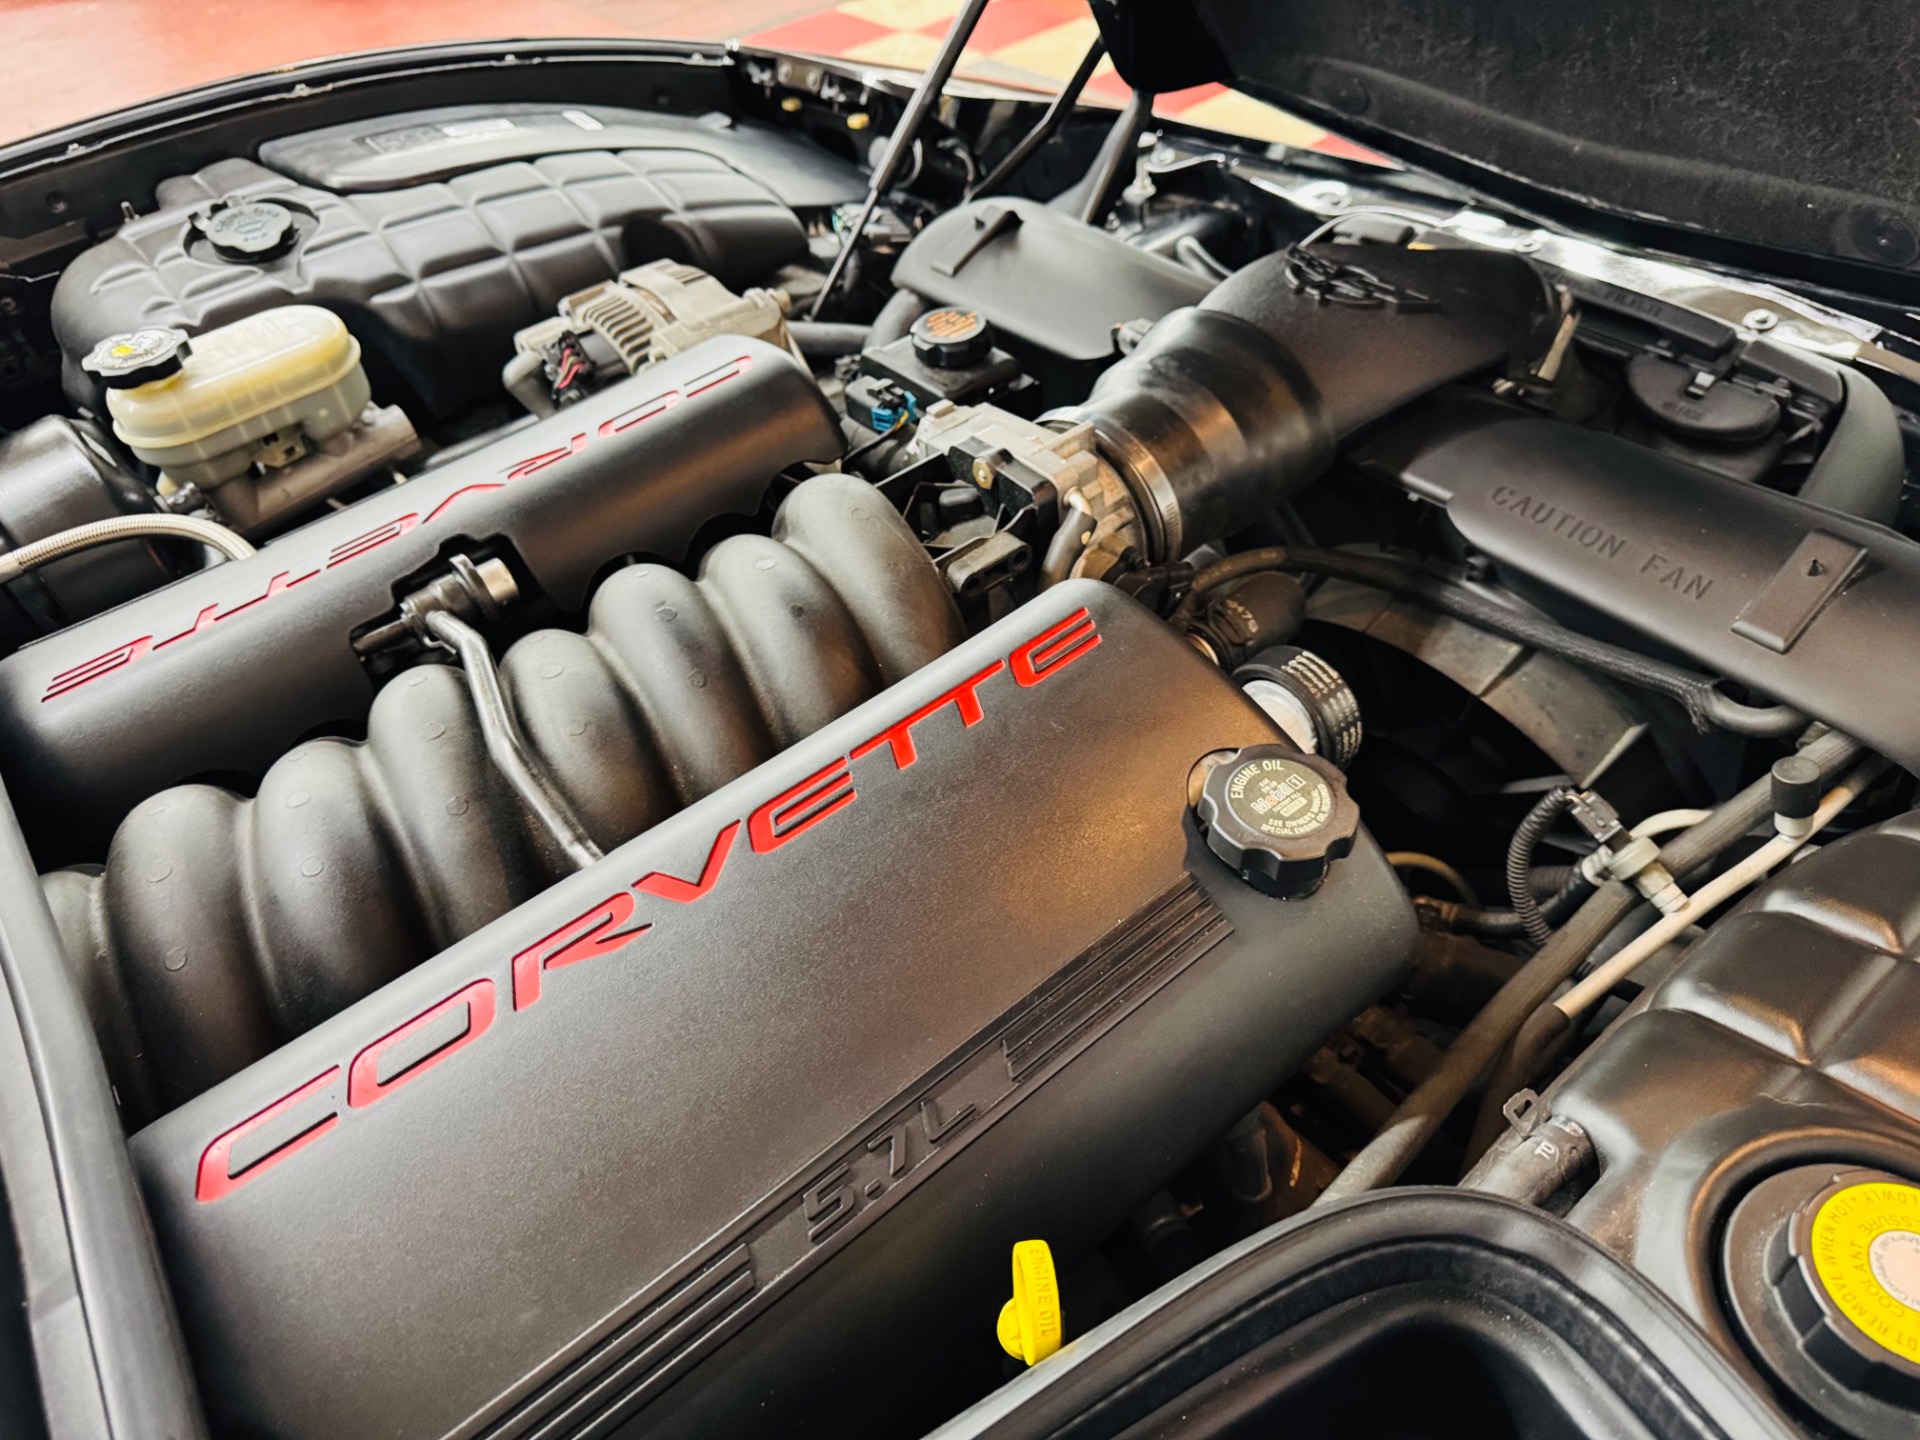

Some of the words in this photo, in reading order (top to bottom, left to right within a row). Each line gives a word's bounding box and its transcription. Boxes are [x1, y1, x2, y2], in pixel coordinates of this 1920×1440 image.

[1490, 482, 1628, 559] CAUTION
[1637, 552, 1716, 602] FAN
[1230, 763, 1261, 799] ENGINE
[1262, 760, 1285, 772] OIL
[1250, 781, 1294, 815] Mobil
[1260, 824, 1293, 835] SPECIAL
[1268, 817, 1284, 827] SEE
[195, 605, 1104, 1203] CORVETTE
[802, 1097, 976, 1244] 5.7L
[1826, 1199, 1852, 1224] HOT
[1864, 1188, 1919, 1205] LOWLY
[1820, 1226, 1838, 1267] WHEN
[1029, 1248, 1053, 1305] ENGINE
[1850, 1240, 1905, 1319] COOLANT
[1039, 1310, 1057, 1336] OIL
[1830, 1271, 1890, 1335] REMOVE
